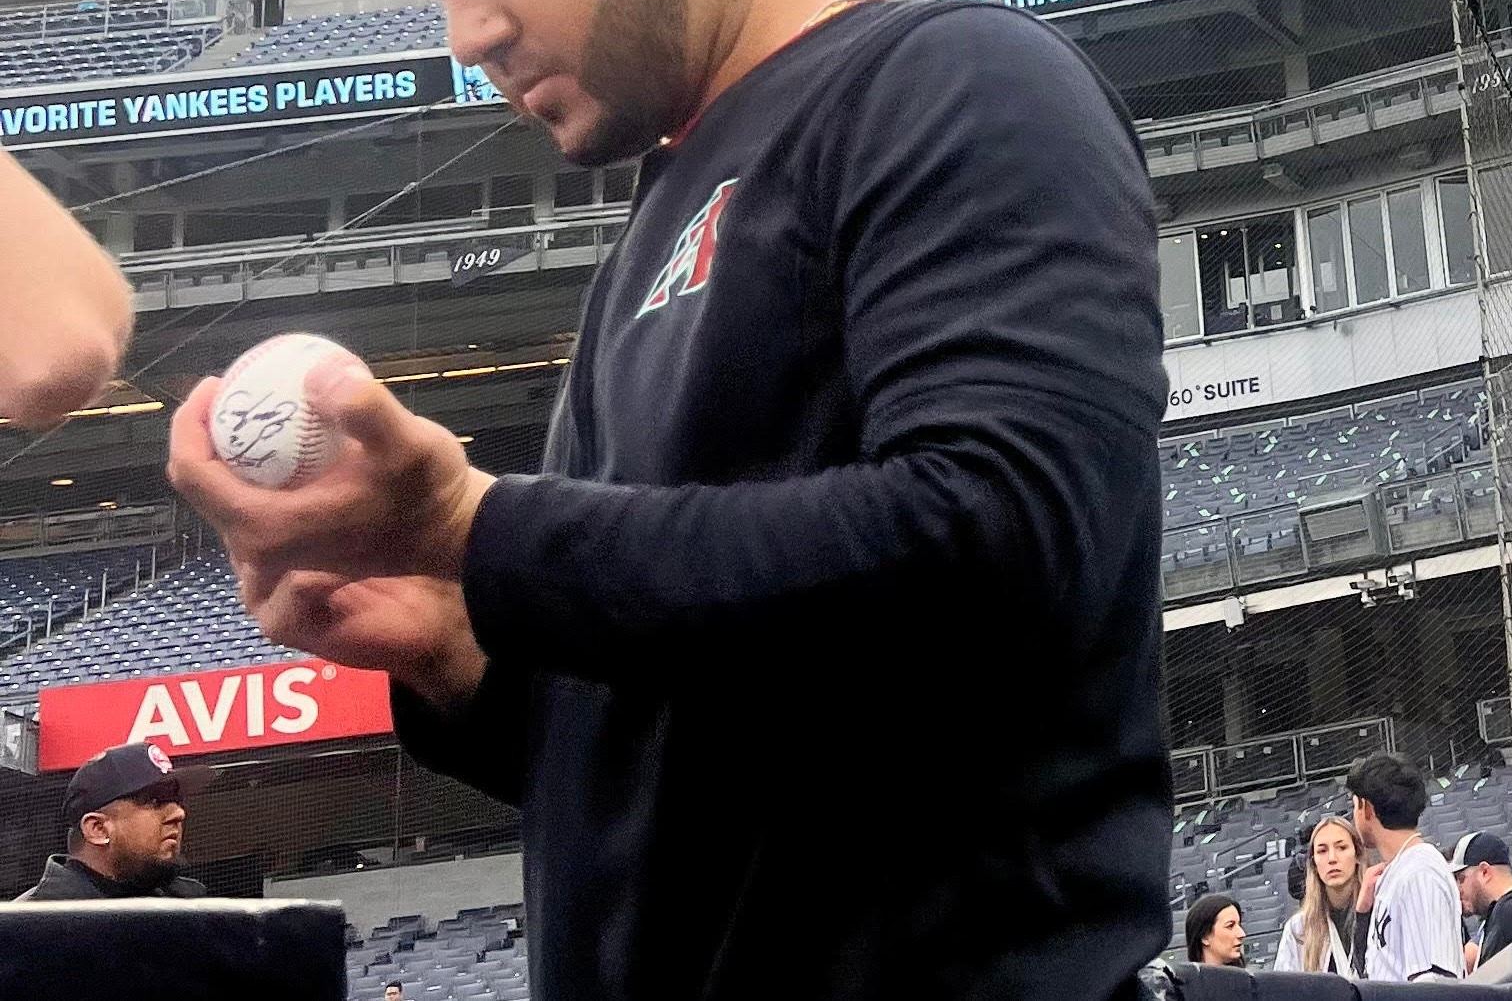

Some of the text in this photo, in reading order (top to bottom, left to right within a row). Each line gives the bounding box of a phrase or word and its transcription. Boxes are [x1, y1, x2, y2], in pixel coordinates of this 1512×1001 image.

[123, 83, 269, 124] YANKEES
[276, 70, 417, 110] PLAYERS
[453, 248, 501, 273] 1949
[1203, 376, 1260, 401] SUITE
